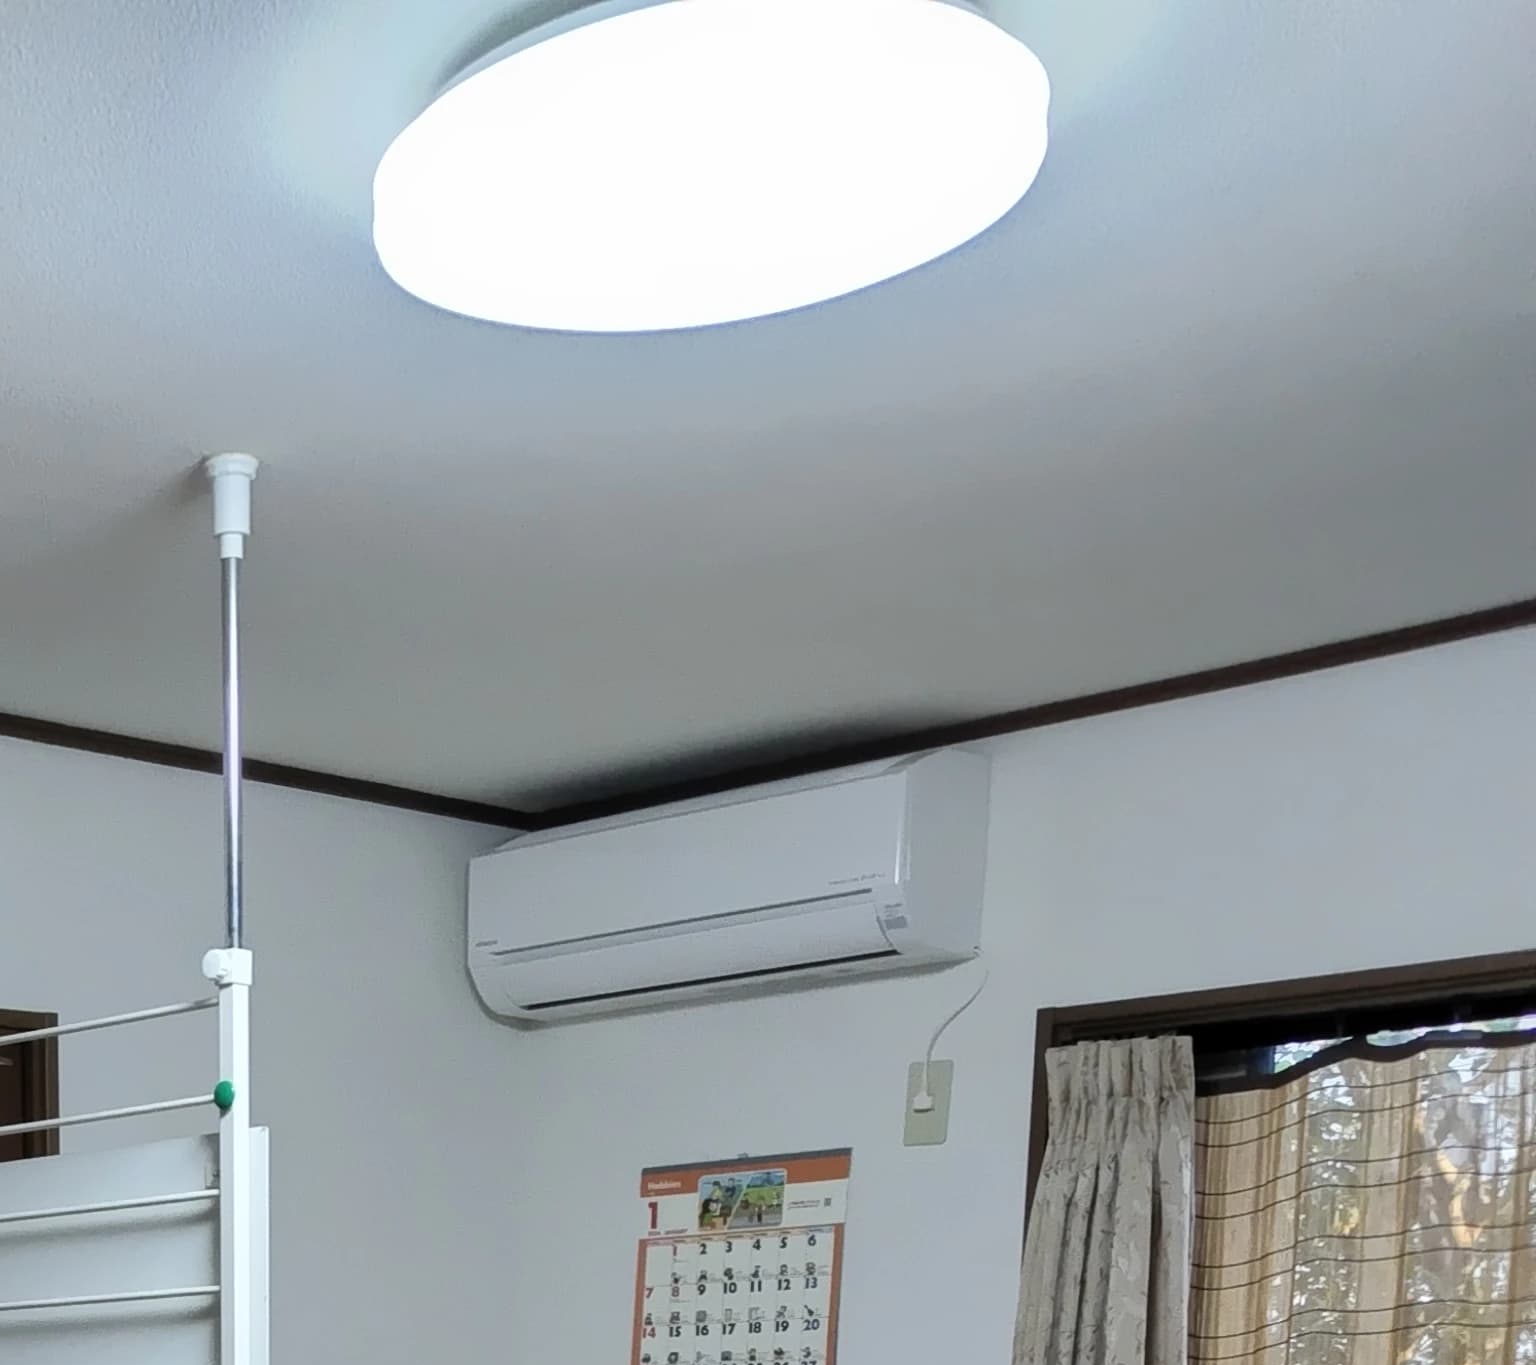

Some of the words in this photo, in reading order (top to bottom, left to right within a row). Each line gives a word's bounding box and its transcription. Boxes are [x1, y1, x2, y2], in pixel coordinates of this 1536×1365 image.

[647, 1202, 659, 1230] 1
[699, 1243, 707, 1255] 2
[725, 1241, 733, 1253] 3
[752, 1239, 761, 1250] 4
[779, 1237, 788, 1248] 5
[807, 1234, 816, 1246] 6
[645, 1287, 654, 1298] 7
[671, 1286, 680, 1297] 8
[697, 1284, 706, 1295] 9
[723, 1282, 737, 1294] 10
[750, 1280, 762, 1292] 11
[777, 1279, 791, 1291] 12
[804, 1277, 818, 1289] 13
[642, 1327, 656, 1338] 14
[669, 1326, 681, 1337] 15
[695, 1325, 709, 1336] 16
[722, 1323, 736, 1335] 17
[748, 1321, 762, 1334] 18
[775, 1321, 789, 1332] 19
[803, 1318, 820, 1331] 20
